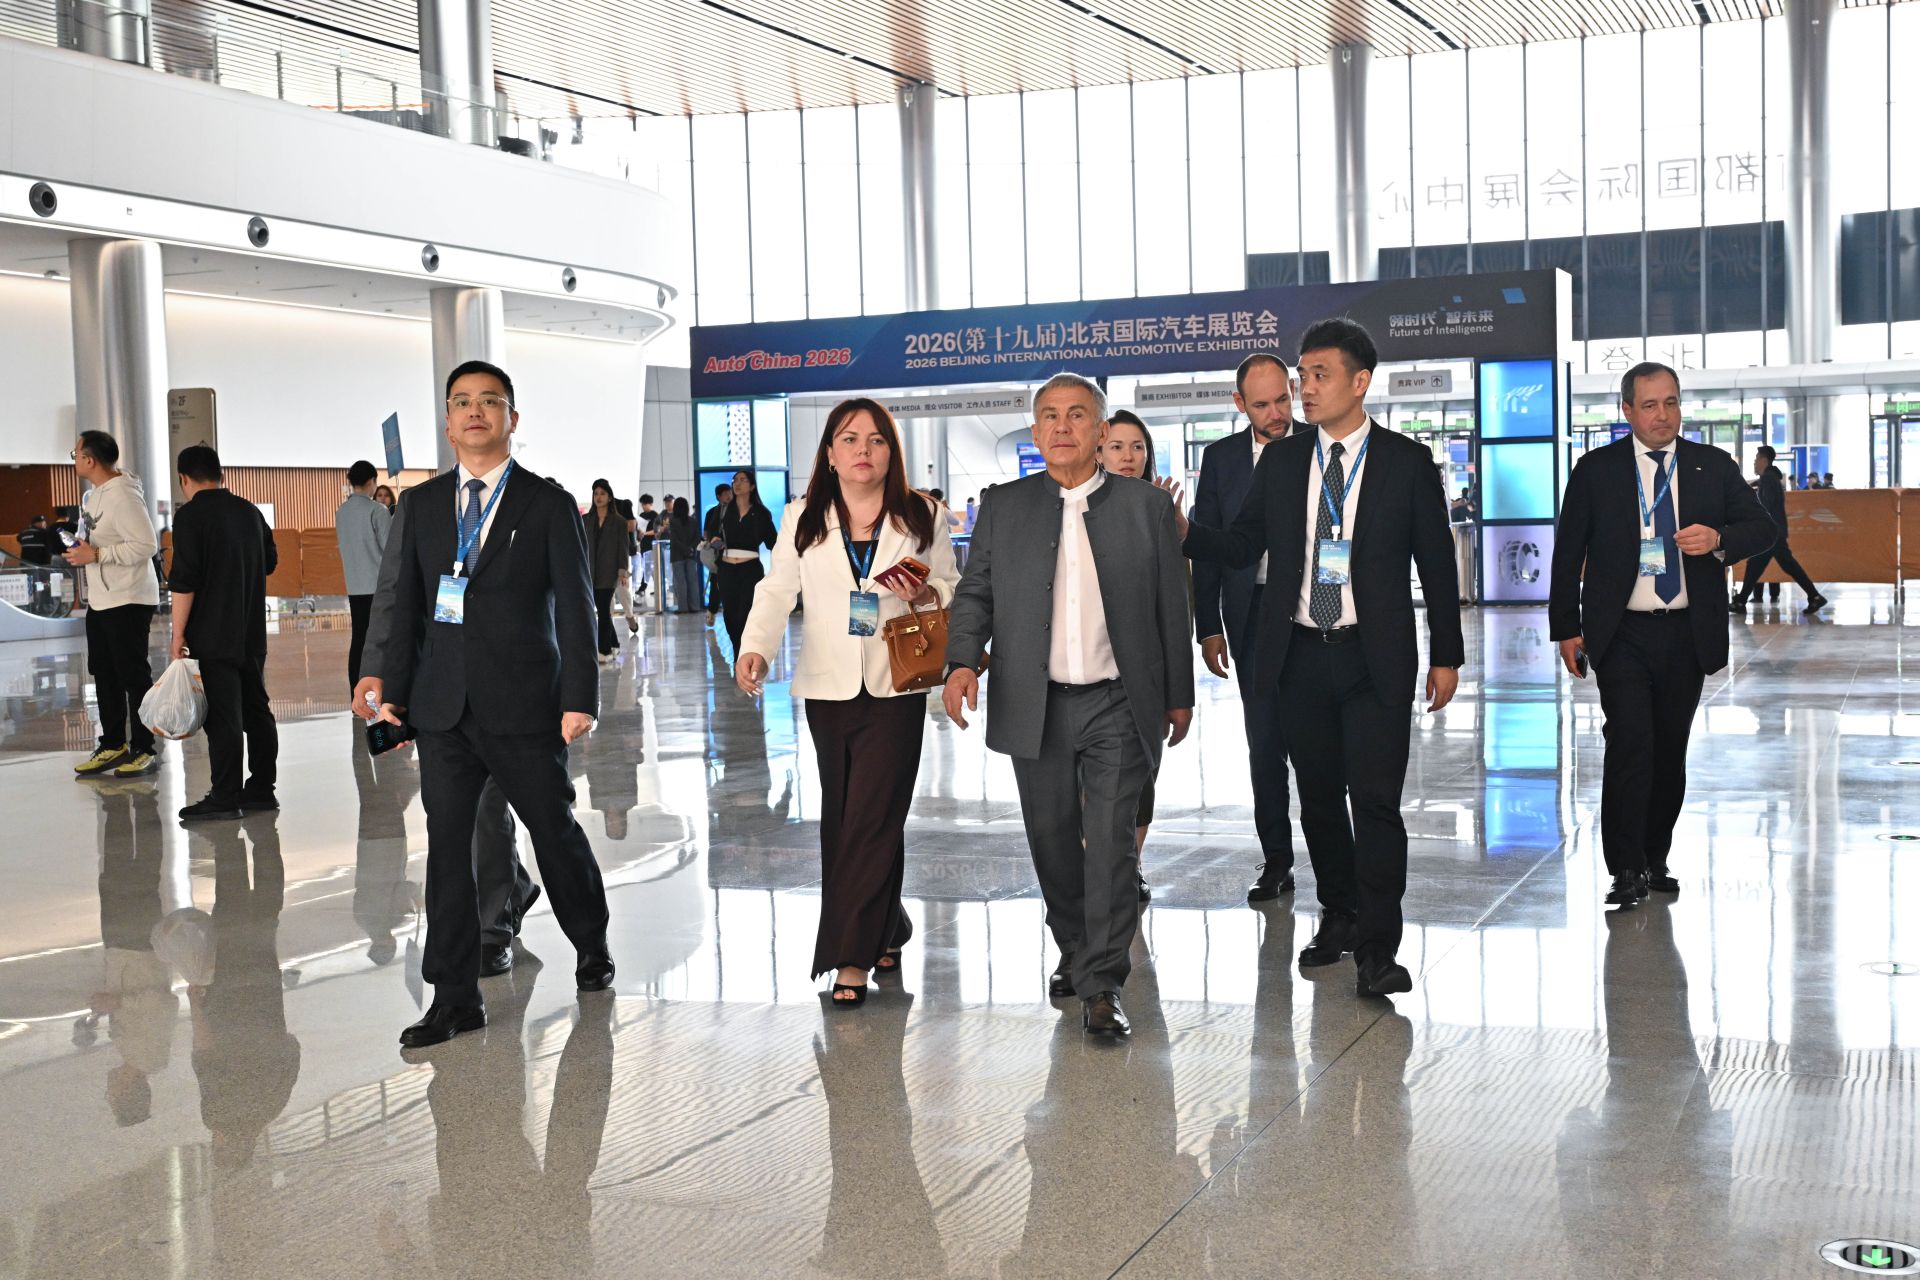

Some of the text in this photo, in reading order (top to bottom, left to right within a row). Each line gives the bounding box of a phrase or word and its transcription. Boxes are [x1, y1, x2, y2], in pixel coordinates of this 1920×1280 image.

[1389, 309, 1494, 328] 领时代 智未来
[1389, 324, 1494, 337] Future of Intelligence
[905, 337, 1280, 369] 2026 BEIJING INTERNATIONAL AUTOMOTIVE EXHIBITION
[703, 347, 851, 374] Auto China 2026
[1413, 378, 1426, 387] VIP
[1156, 391, 1192, 400] EXHIBITOR
[1211, 389, 1233, 398] MEDIA
[901, 404, 921, 412] MEDIA
[938, 402, 963, 410] VISITOR
[966, 400, 991, 409] 工作人员
[992, 399, 1012, 408] STAFF
